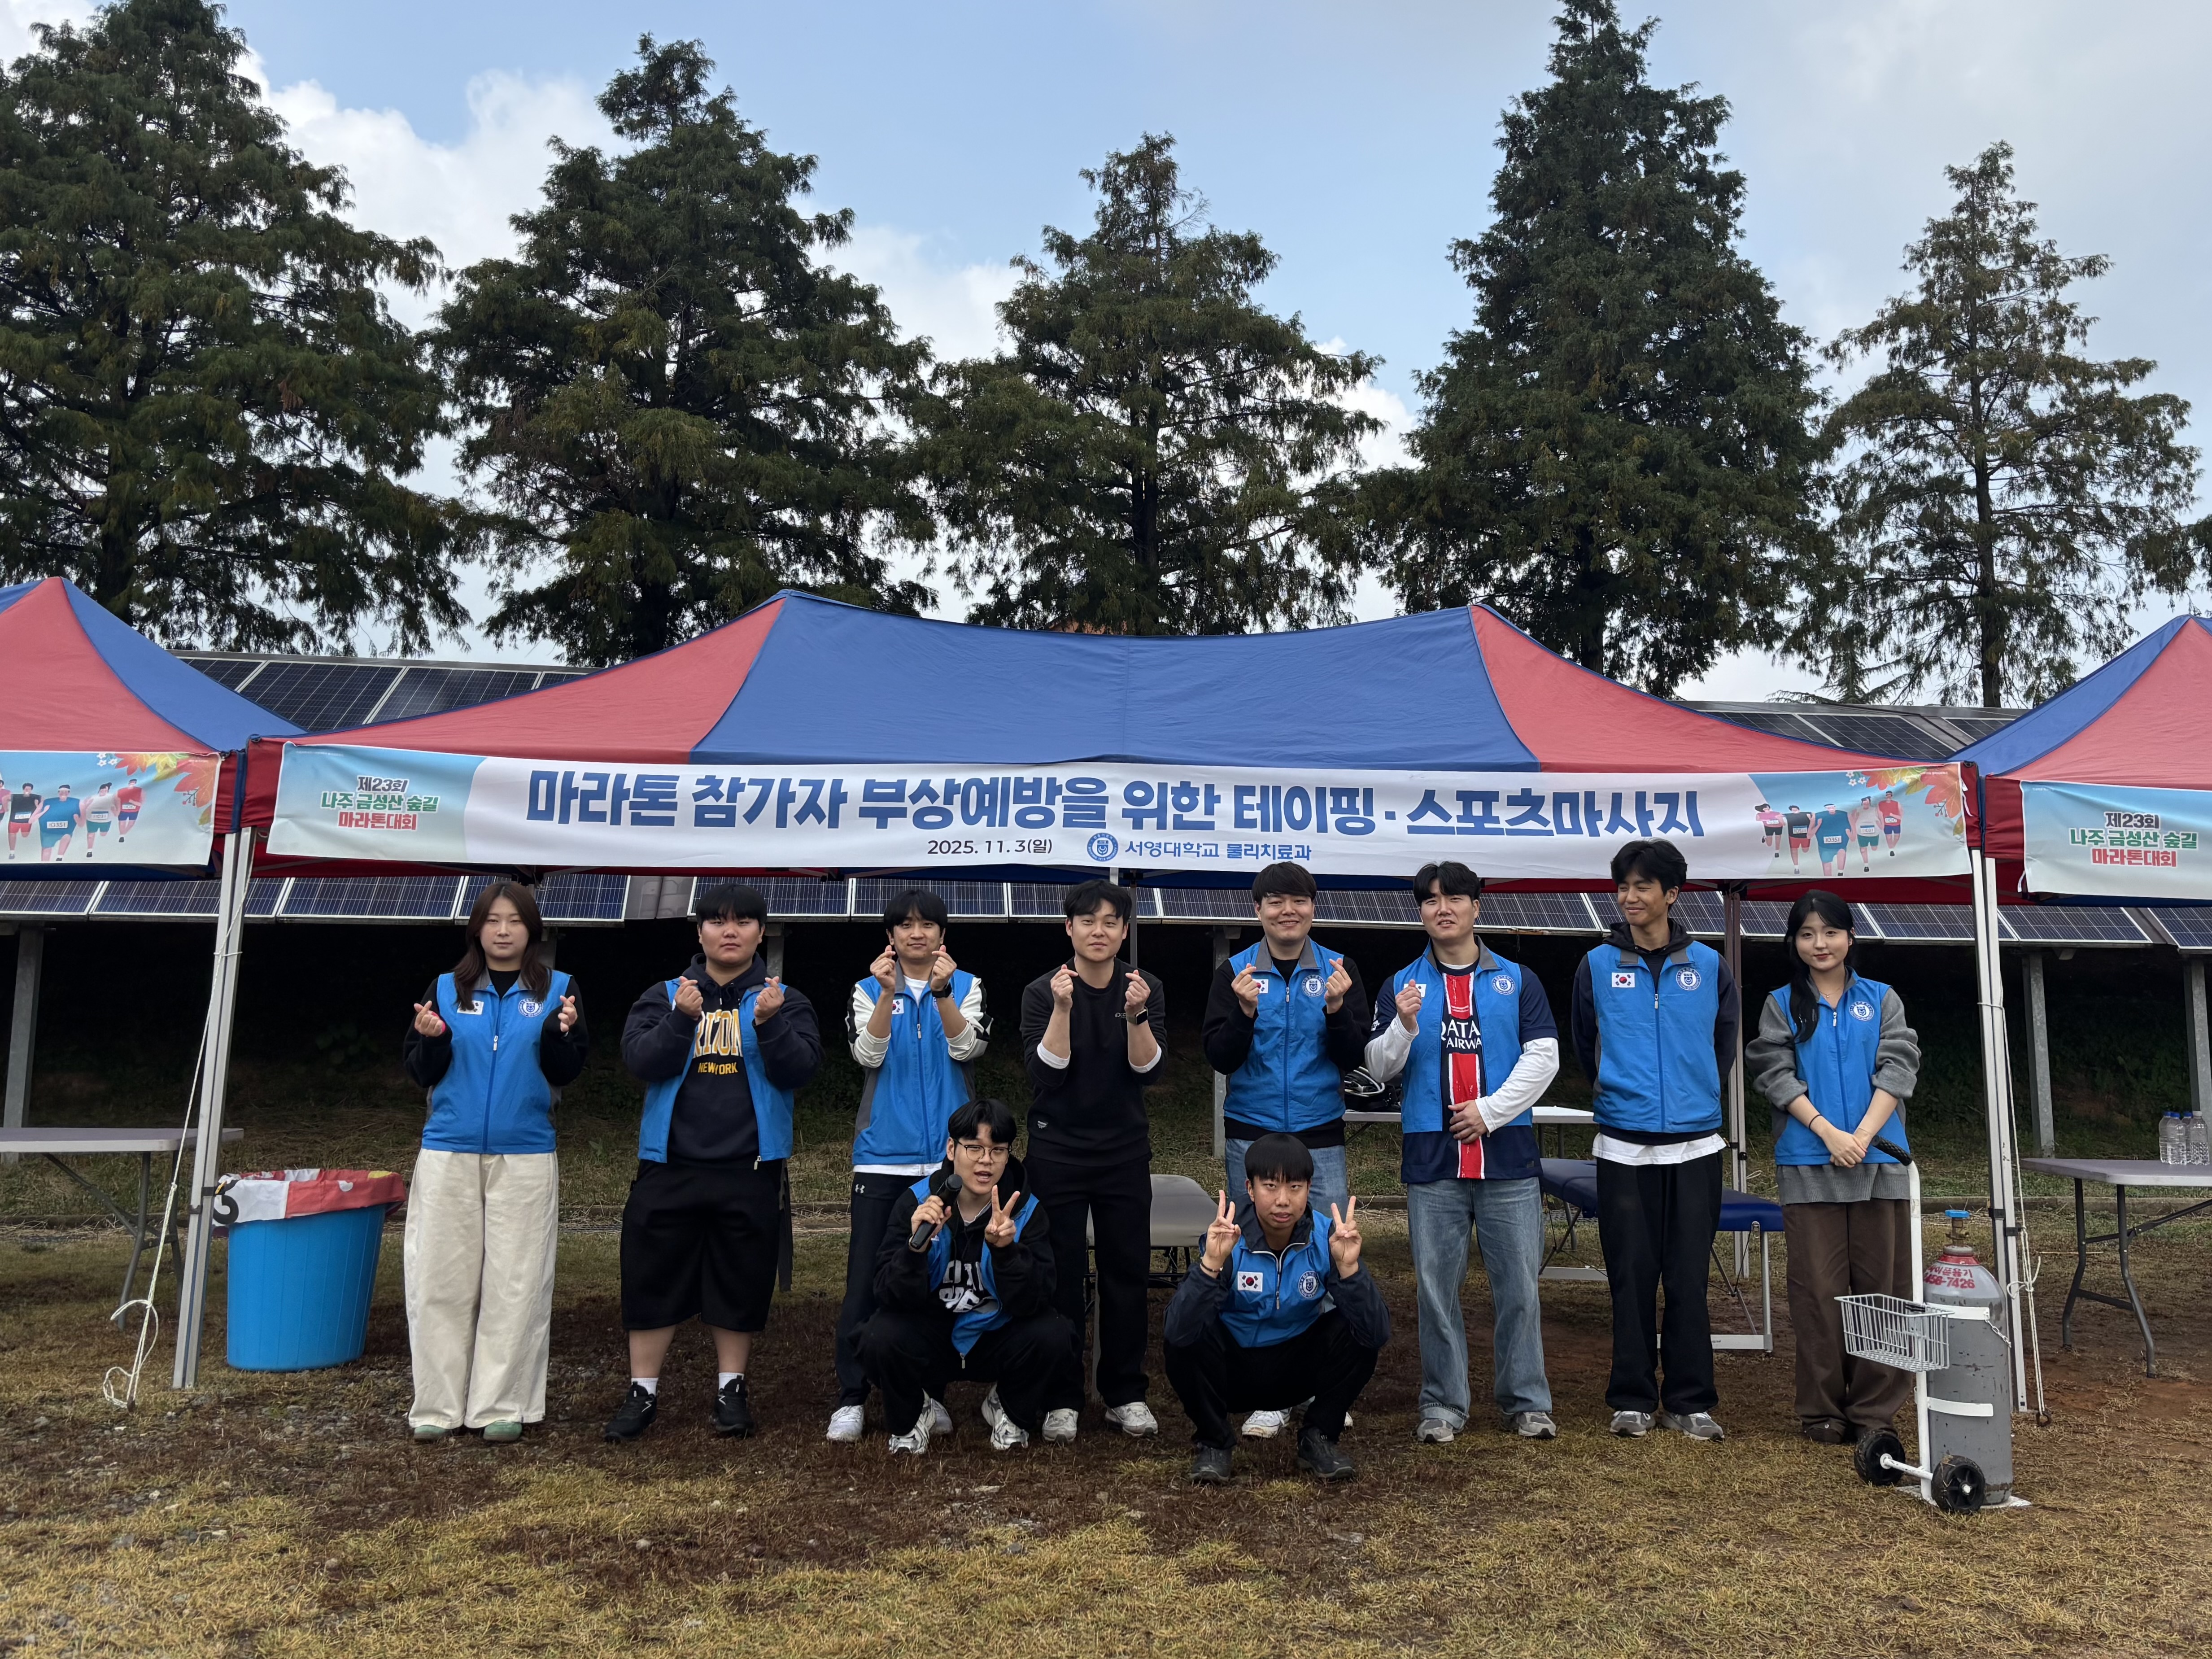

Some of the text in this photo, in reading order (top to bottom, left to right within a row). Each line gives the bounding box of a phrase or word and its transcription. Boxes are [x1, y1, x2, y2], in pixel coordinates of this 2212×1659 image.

[358, 776, 408, 793] 제23회
[321, 792, 440, 813] 나주 금성산 숲길
[526, 770, 680, 827] 마라톤
[691, 774, 848, 830] 참가자
[858, 776, 1109, 830] 부상예방을
[1121, 780, 1221, 831] 위한
[1234, 784, 1376, 836] 테이핑
[1406, 788, 1705, 837] 스포츠마사지
[338, 813, 417, 830] 마라톤대회
[2106, 813, 2160, 829] 제23회
[2070, 829, 2197, 849] 나주 금성산 숲길
[1125, 840, 1220, 858] 서영대학교
[1226, 843, 1312, 861] 물리치료과
[2092, 848, 2177, 867] 마라톤대회
[698, 1062, 716, 1073] NEW
